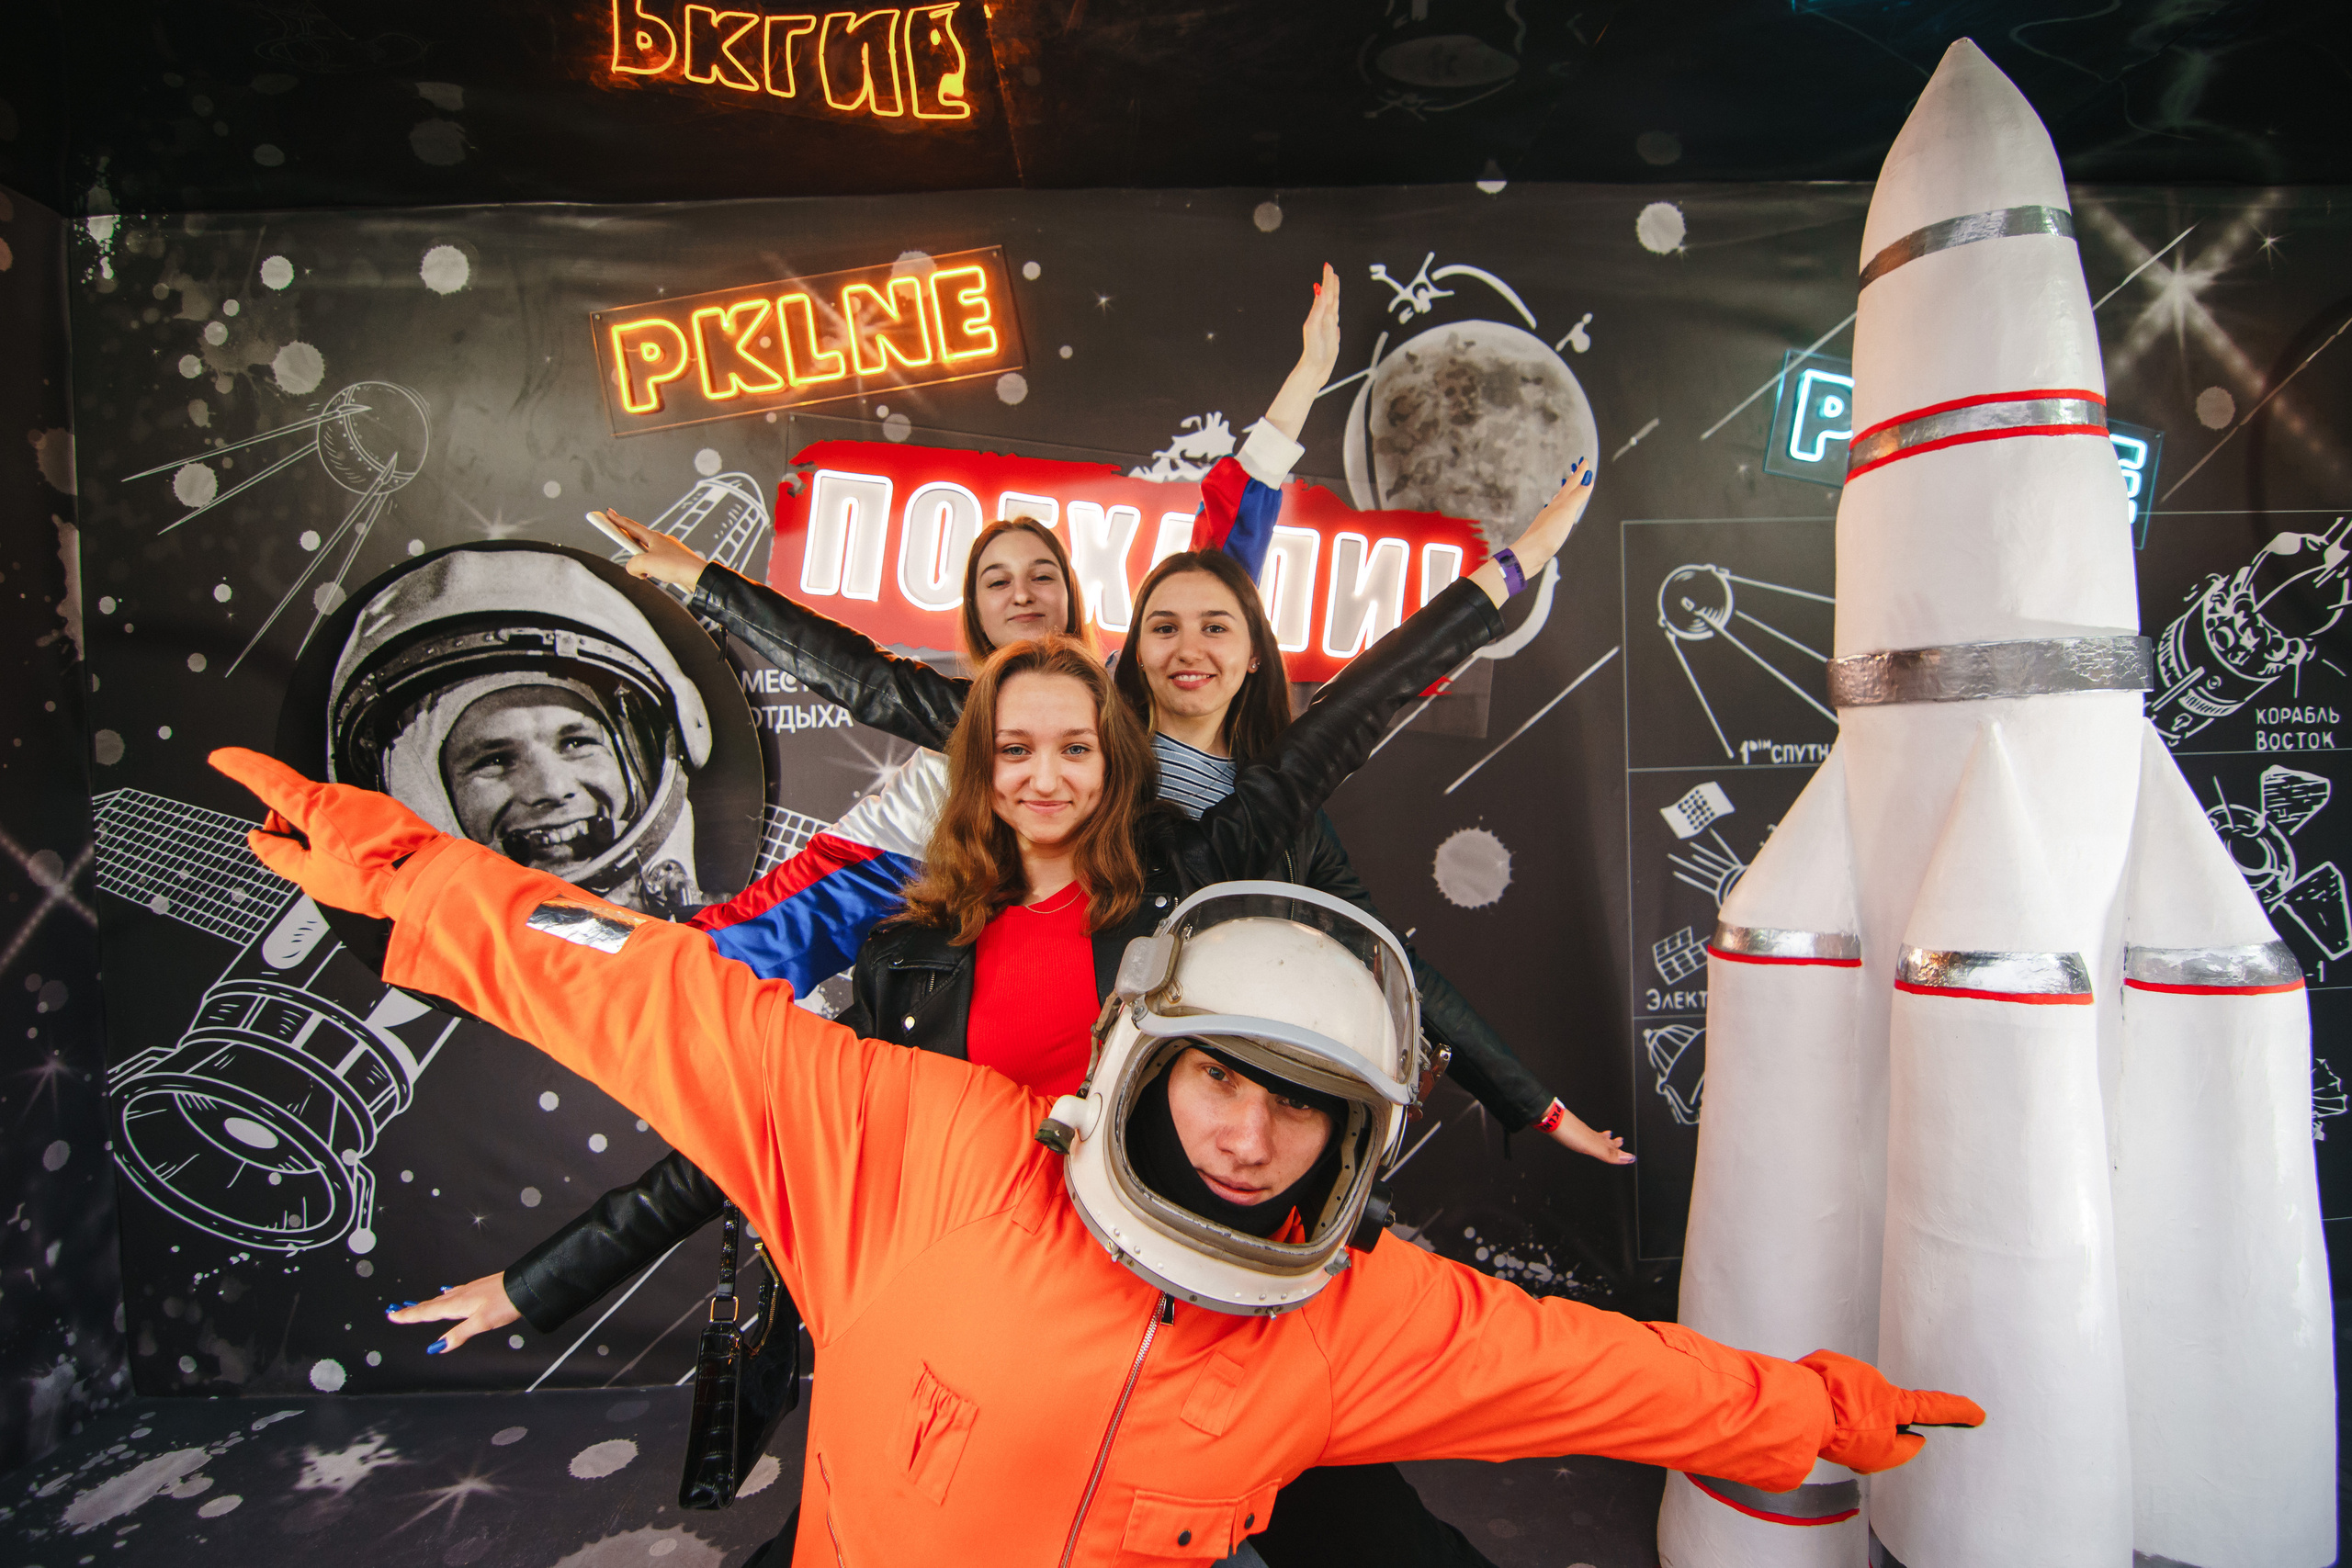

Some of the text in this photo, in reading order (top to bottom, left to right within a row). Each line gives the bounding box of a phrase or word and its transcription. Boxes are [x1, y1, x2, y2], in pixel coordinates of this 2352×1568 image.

[611, 265, 998, 413] PKLNE
[800, 468, 1463, 659] ПОХЛИ!
[741, 669, 809, 694] МЕС
[2255, 705, 2340, 725] КОРАБЛЬ
[2255, 730, 2335, 750] ВОСТОК
[1770, 743, 1834, 764] СПУТН
